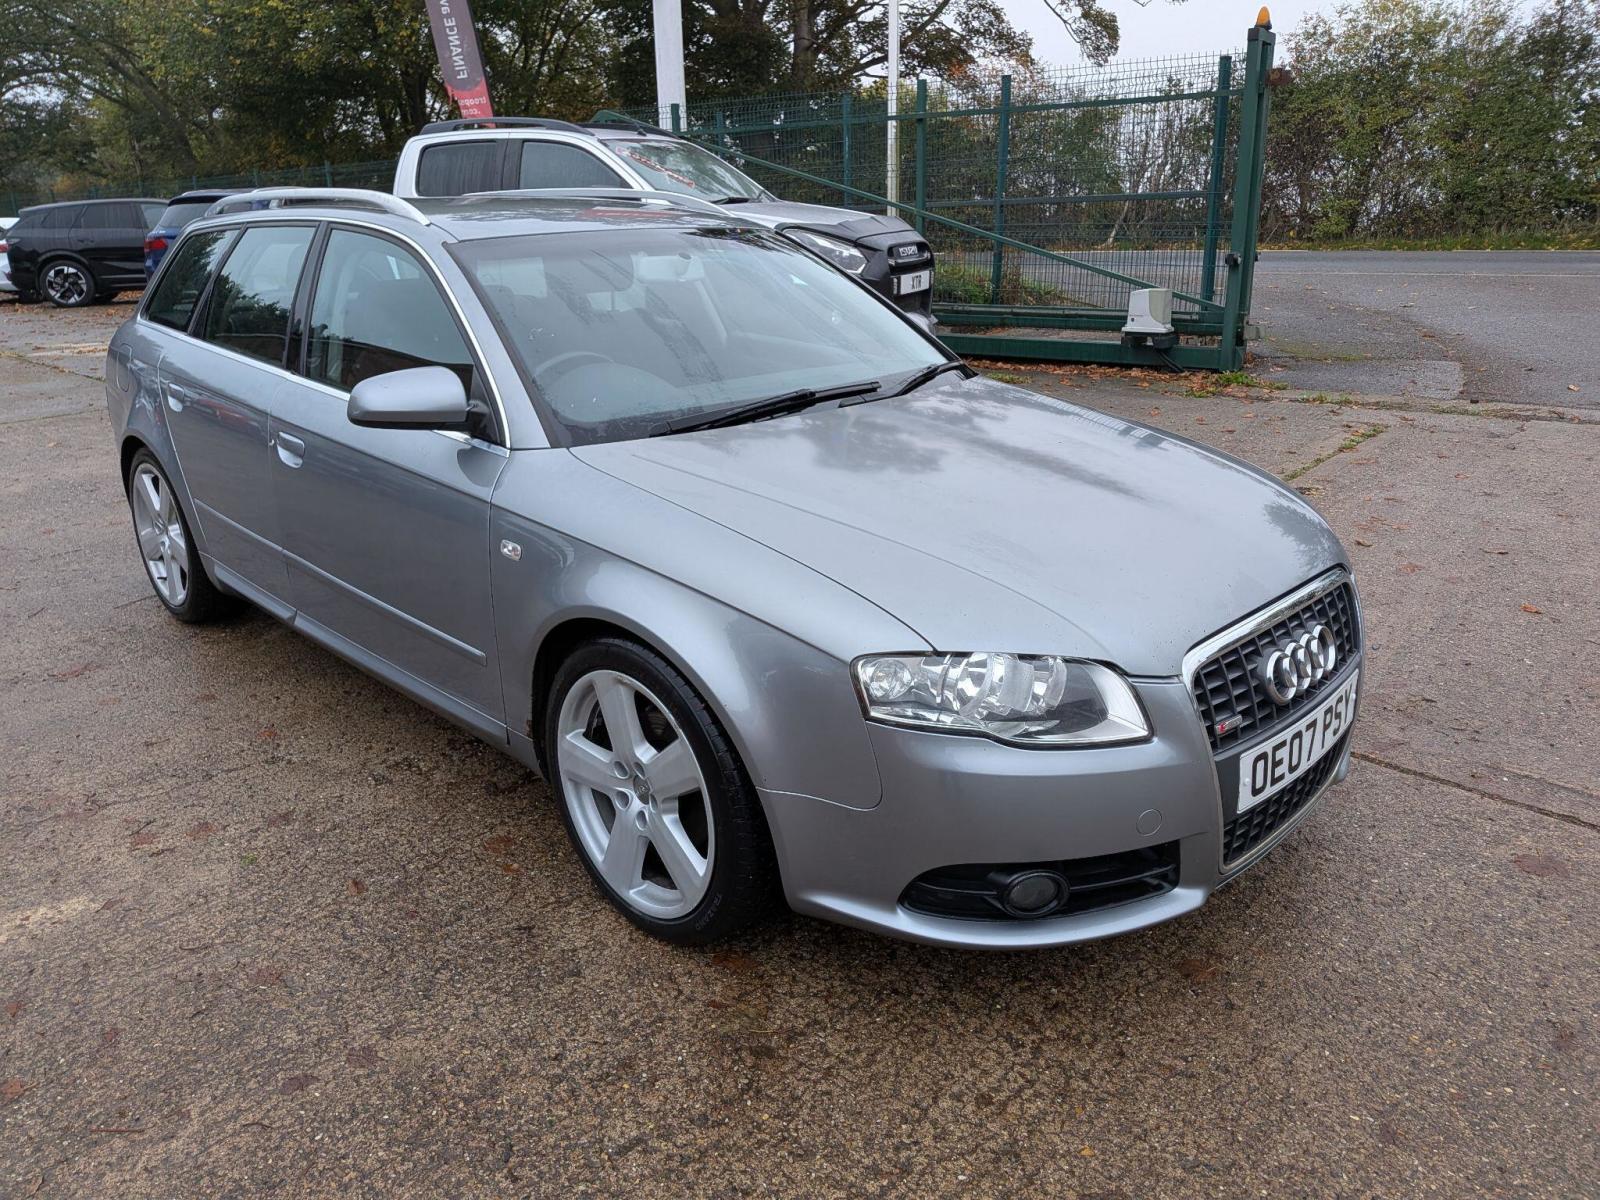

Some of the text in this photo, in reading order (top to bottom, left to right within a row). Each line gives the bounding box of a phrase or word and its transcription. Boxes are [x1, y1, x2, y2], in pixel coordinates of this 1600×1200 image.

[899, 245, 918, 257] ISUZU
[912, 274, 922, 290] XTR
[1251, 683, 1353, 797] OE07 PSY
